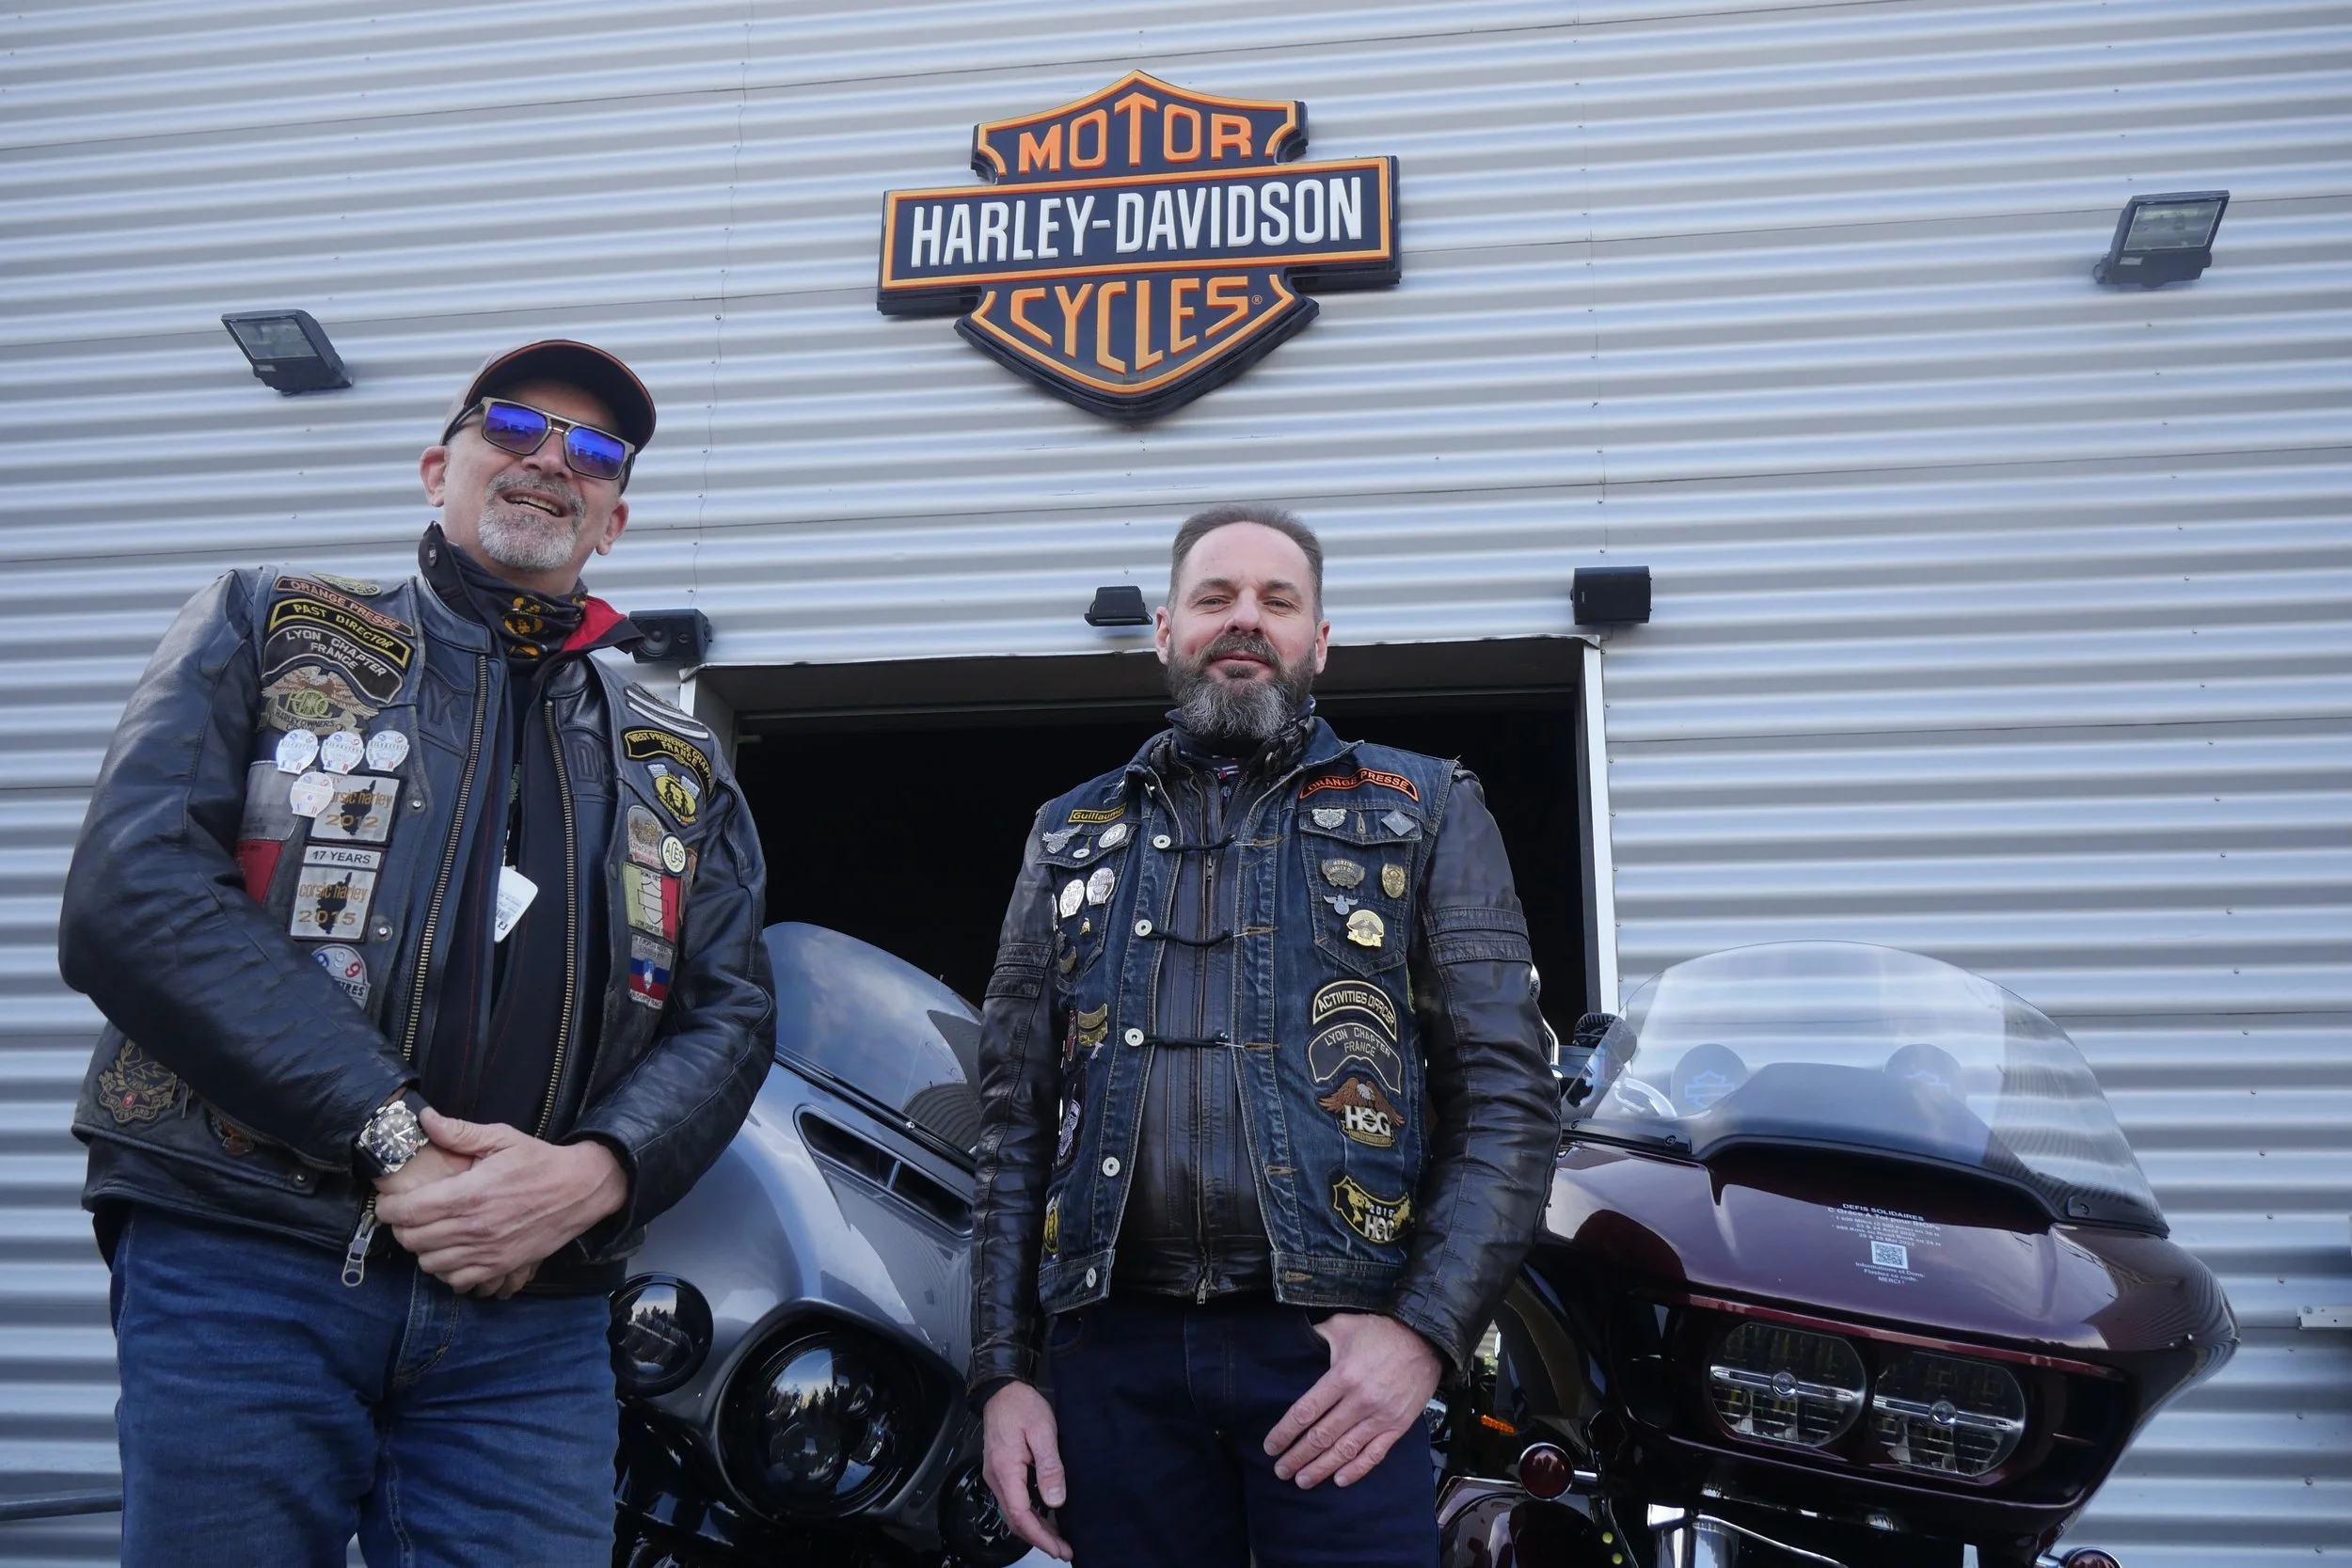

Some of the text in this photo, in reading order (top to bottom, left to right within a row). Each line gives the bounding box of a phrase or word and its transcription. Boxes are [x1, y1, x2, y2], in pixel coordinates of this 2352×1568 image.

[1018, 91, 1252, 173] MOTOR
[911, 176, 1362, 268] HARLEY-DAVIDSON
[290, 580, 345, 606] ORANGE
[349, 602, 400, 630] PRESSE
[293, 604, 394, 649] PAST DIRECTOR
[286, 629, 387, 677] LYON CHAPTER
[310, 642, 358, 671] FRANCE
[275, 708, 335, 730] HARLEY OWNERS
[628, 733, 650, 743] WEST
[650, 733, 691, 753] PROVENCE
[660, 741, 697, 767] FRANCE
[1308, 770, 1409, 792] ORANGE PRESSE
[358, 791, 393, 809] harley
[325, 815, 380, 829] 2012
[1073, 805, 1125, 820] Guillaume
[312, 850, 371, 864] 17 YEARS
[665, 841, 684, 863] ACES
[298, 882, 369, 904] corsic harley
[299, 910, 357, 927] 2015
[1318, 990, 1396, 1027] ACTIVITIES OFFICER
[1325, 1027, 1391, 1058] LYON CHAPTER
[1343, 1041, 1376, 1057] FRANCE
[1344, 1104, 1392, 1137] HOG
[1842, 1203, 1925, 1222] DEFIS SOLIDAIRES
[1855, 1261, 1897, 1273] Informations
[1878, 1275, 1900, 1284] MERCI
